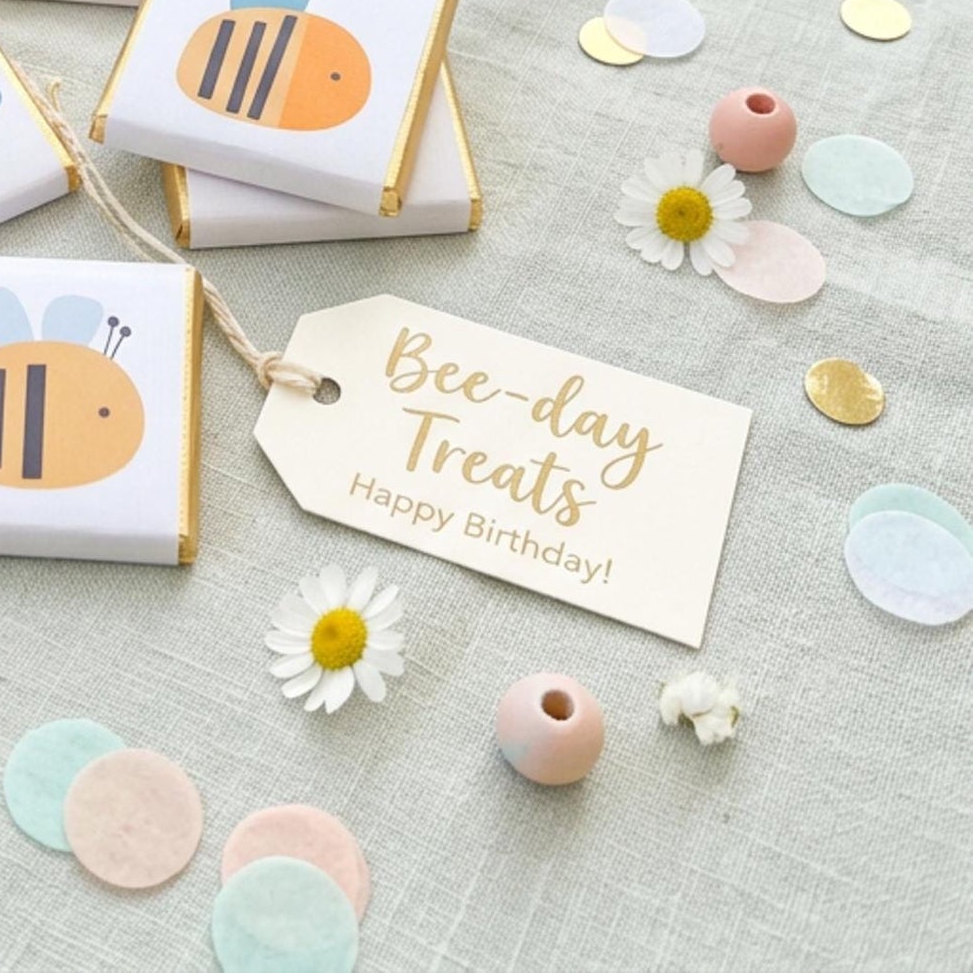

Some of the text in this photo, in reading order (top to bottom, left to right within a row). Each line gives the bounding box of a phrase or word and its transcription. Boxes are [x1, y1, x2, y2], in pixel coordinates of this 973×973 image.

[386, 328, 663, 490] Bee-day
[403, 408, 597, 527] Treats
[349, 473, 613, 584] Happy Birthday!
